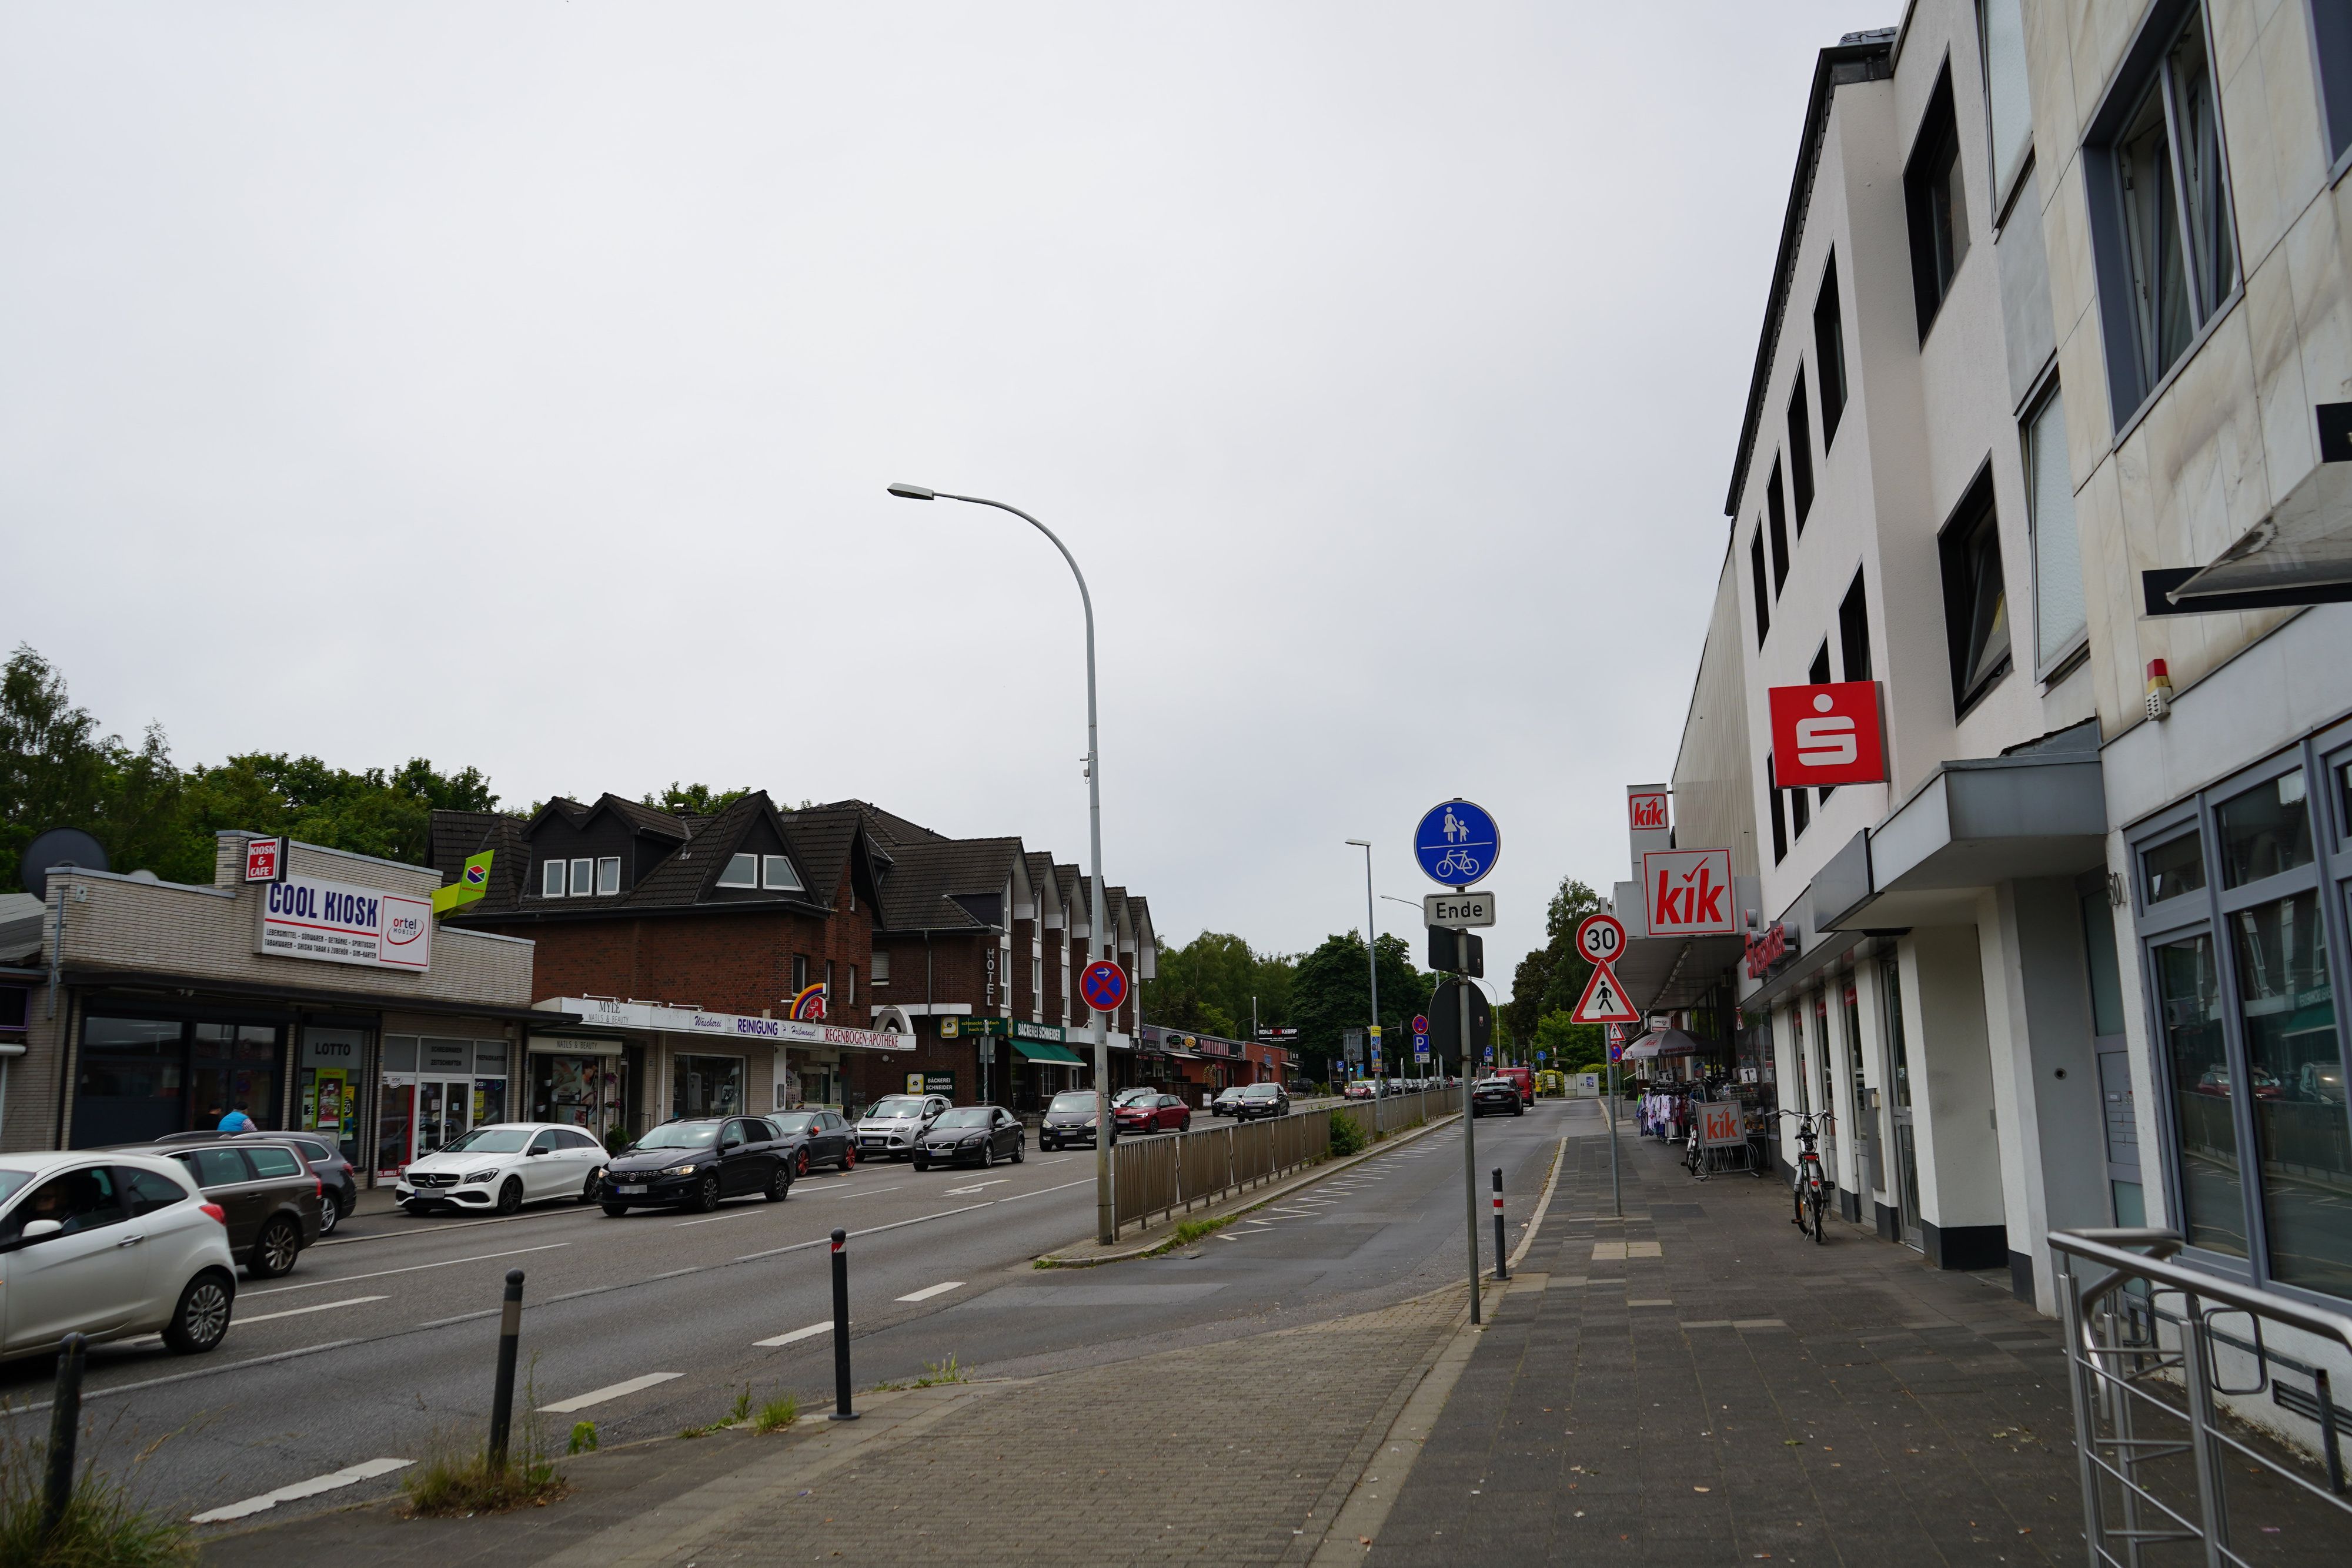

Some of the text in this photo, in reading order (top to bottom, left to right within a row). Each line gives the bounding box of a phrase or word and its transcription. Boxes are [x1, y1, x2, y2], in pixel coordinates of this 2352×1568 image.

[1634, 798, 1663, 825] kik
[250, 845, 275, 855] KIOSK
[258, 857, 266, 865] &
[1656, 857, 1725, 925] kik
[269, 882, 378, 927] COOL KIOSK
[1436, 901, 1482, 919] Ende
[393, 917, 417, 930] ortel
[266, 928, 297, 939] LEBENSMITTEL
[393, 928, 416, 936] MOBILE
[1588, 928, 1615, 951] 30
[265, 939, 292, 948] TABAKWAREN
[298, 943, 312, 951] SHISHA
[331, 947, 348, 955] ZUBEHÖR
[589, 1014, 603, 1022] NAILS
[612, 1015, 629, 1024] BEAUTY
[737, 1018, 778, 1036] REINIGUNG
[1018, 1021, 1061, 1041] BÄCKEREI SCHNEIDER
[315, 1042, 351, 1056] LOTTO
[556, 1039, 597, 1049] NAILS & BEAUTY
[1416, 1037, 1425, 1051] P
[1486, 1047, 1491, 1055] P
[1665, 1045, 1693, 1054] www.kik.de
[1708, 1107, 1737, 1139] kik
